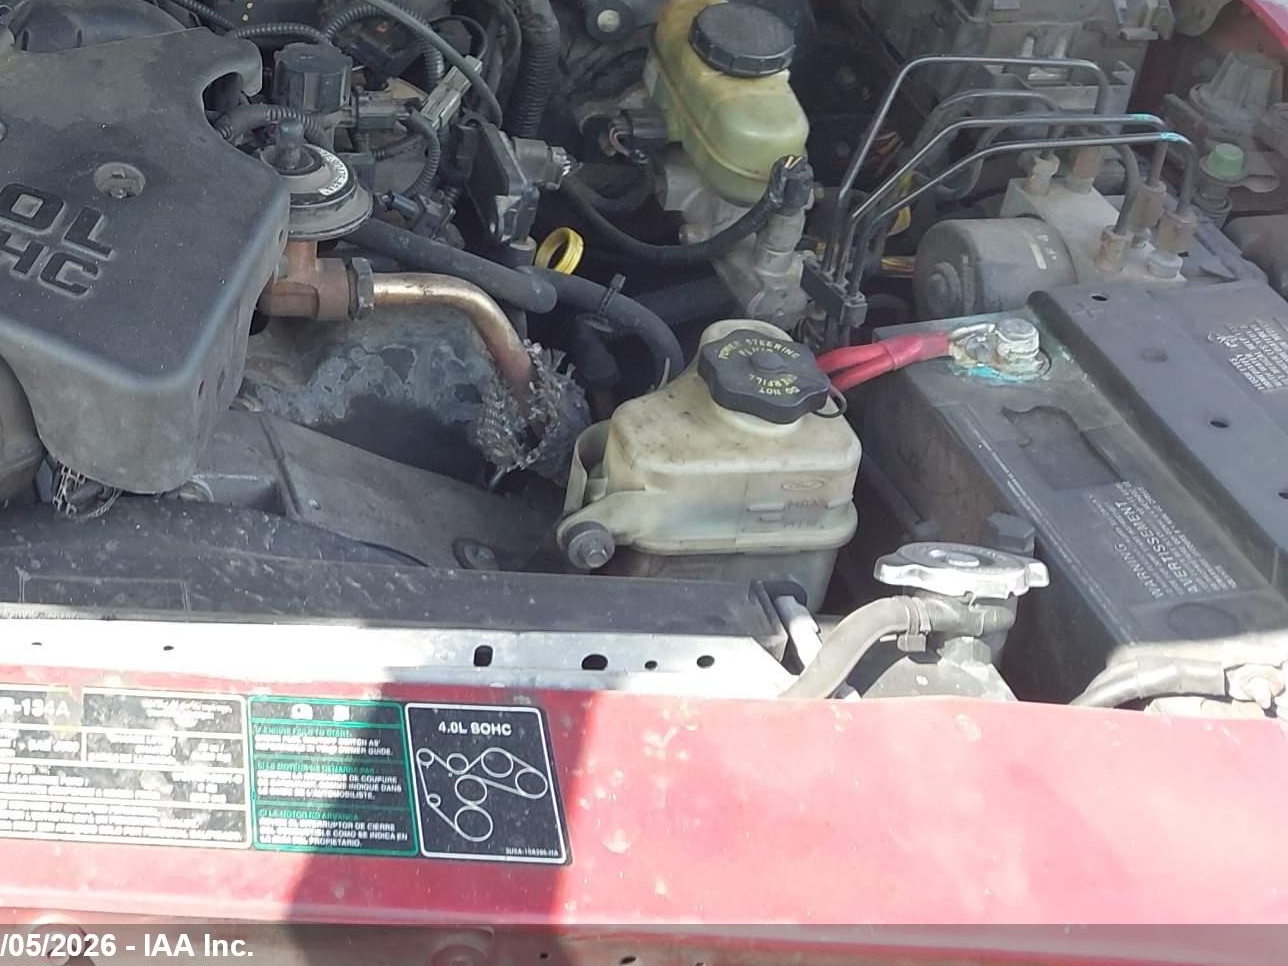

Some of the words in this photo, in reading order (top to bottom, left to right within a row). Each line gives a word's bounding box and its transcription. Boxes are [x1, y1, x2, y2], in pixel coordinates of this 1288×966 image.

[745, 338, 801, 360] STEERING
[1115, 499, 1199, 593] AVERTISSEMENT
[1113, 542, 1164, 600] WARNING
[438, 721, 468, 734] 4.0L
[470, 721, 512, 736] SOHC
